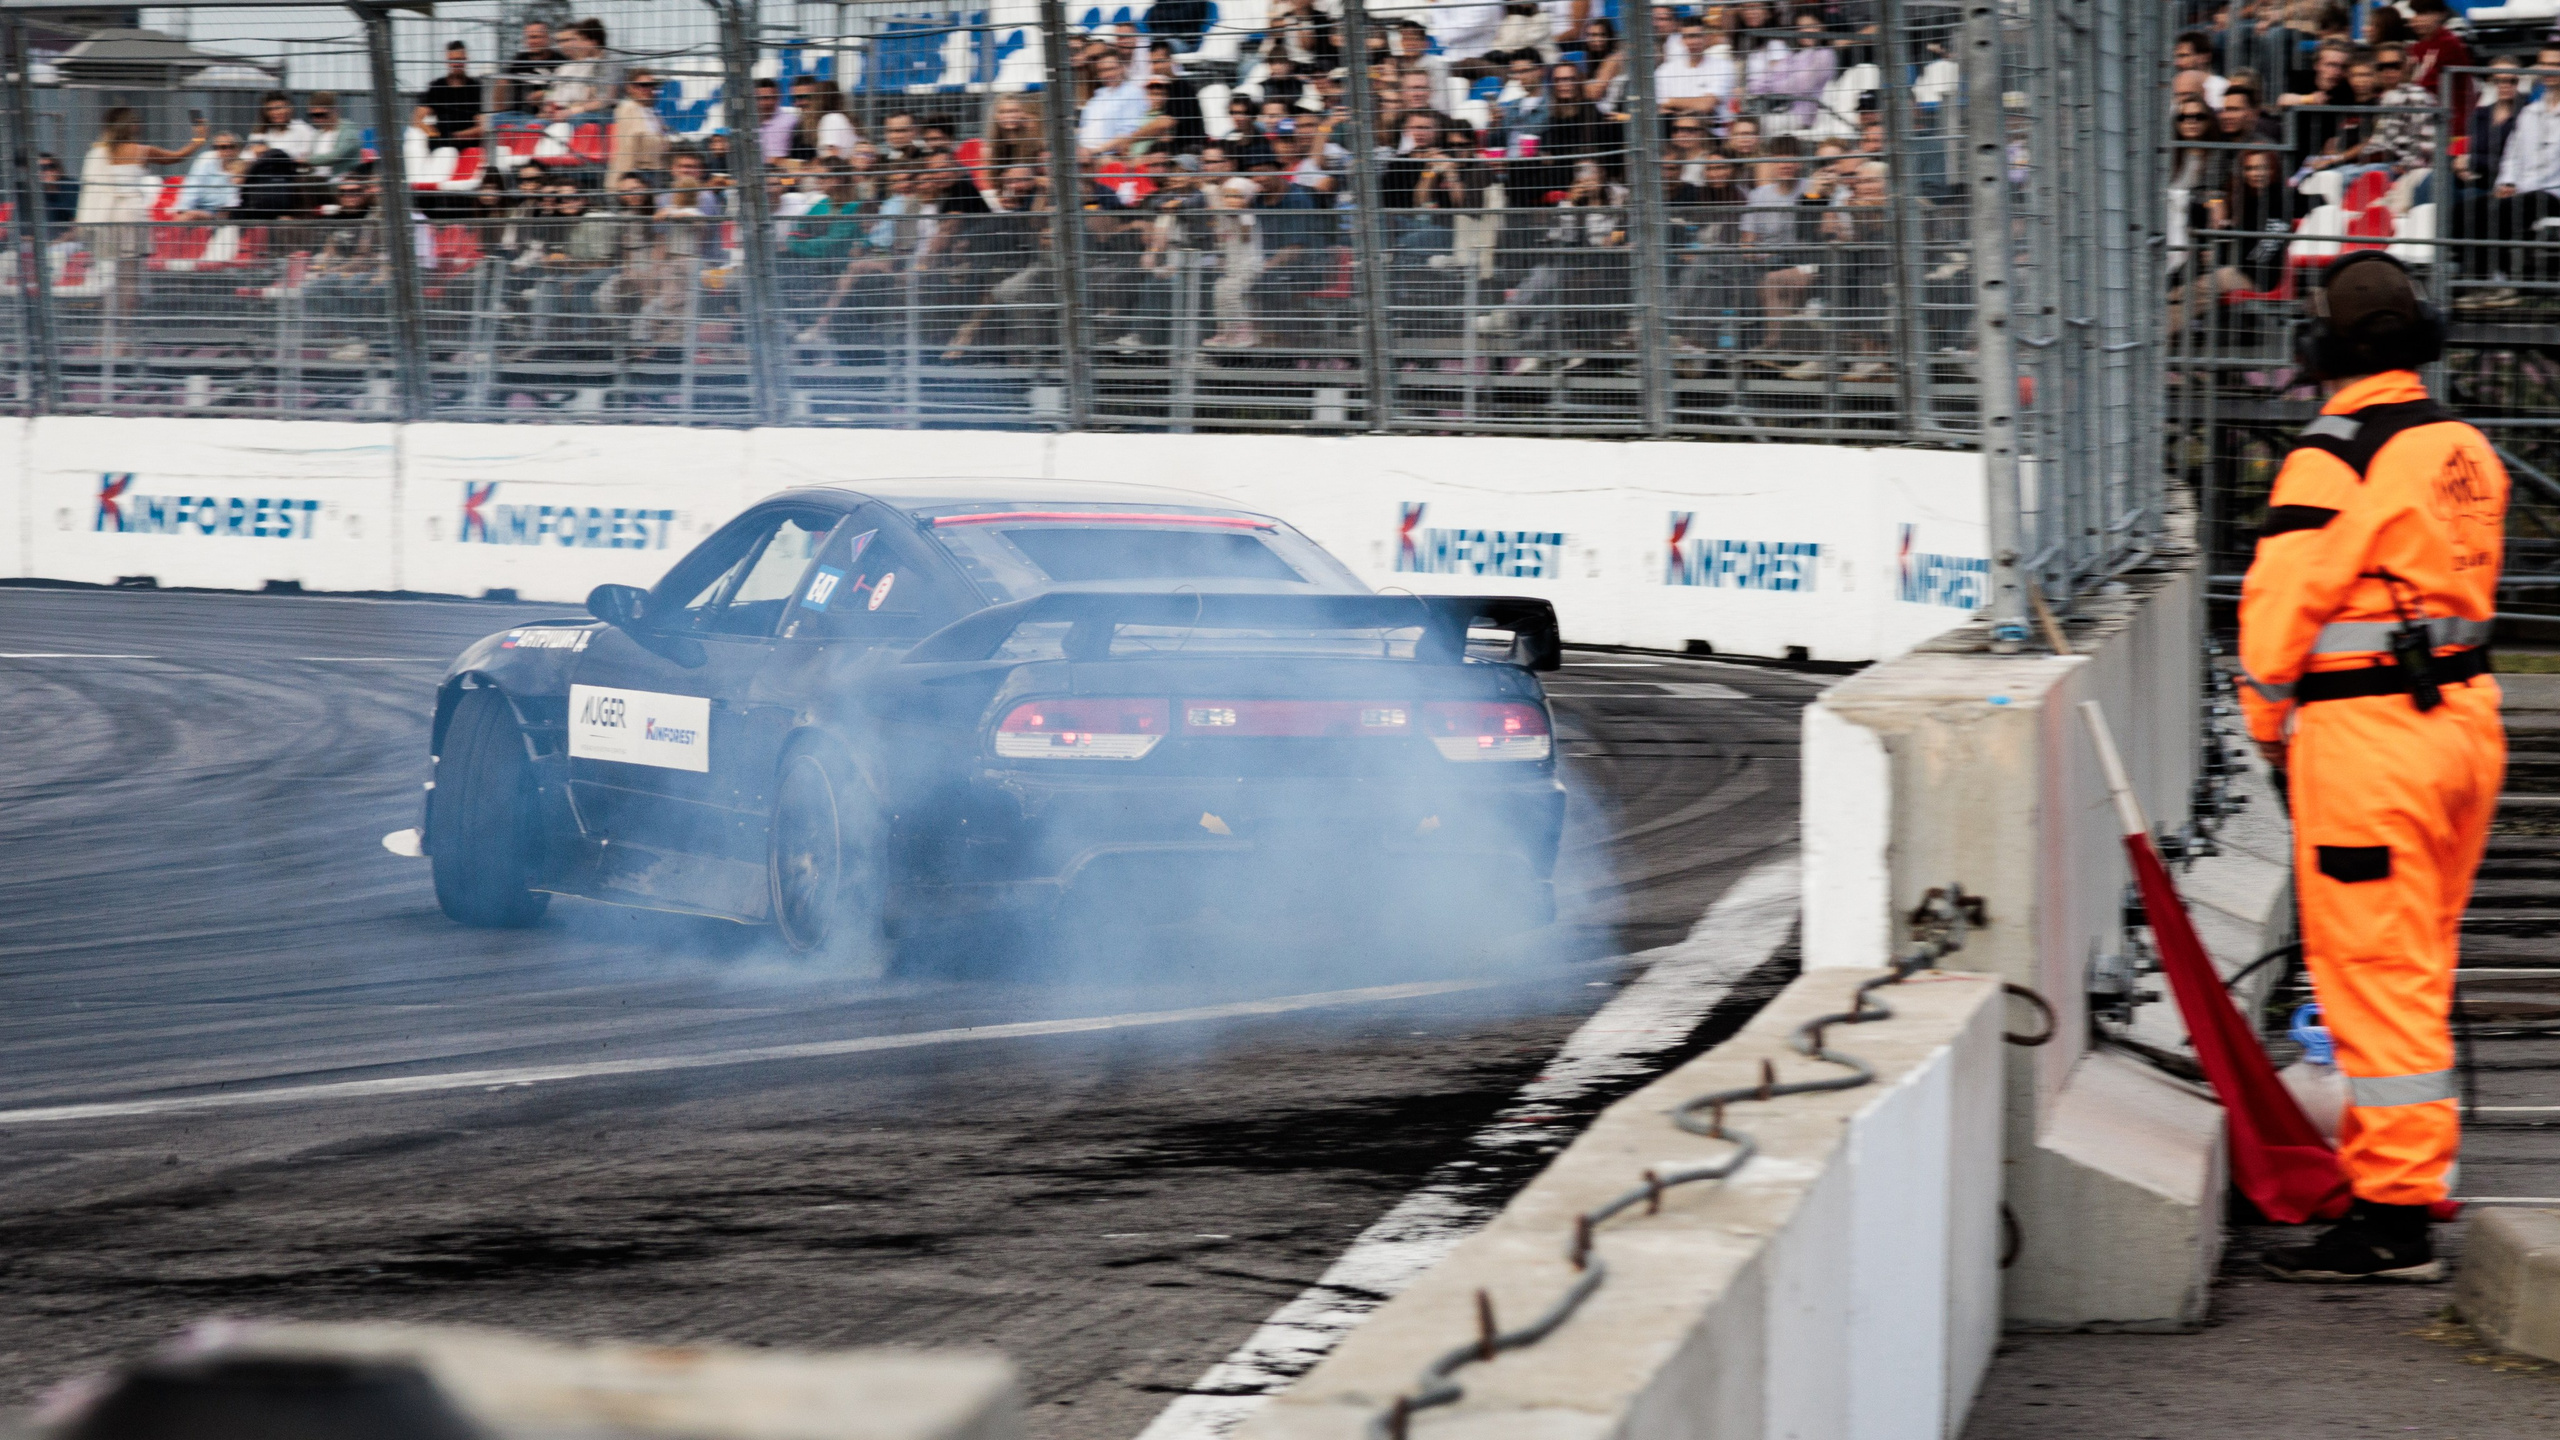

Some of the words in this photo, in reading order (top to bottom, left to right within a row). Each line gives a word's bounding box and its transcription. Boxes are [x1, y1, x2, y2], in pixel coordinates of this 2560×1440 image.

[94, 472, 320, 539] KINFOREST
[459, 481, 675, 550] KINFOREST
[1394, 501, 1567, 579] KINFOREST
[1663, 511, 1820, 592] KINFOREST
[645, 717, 696, 745] KINFOREST
